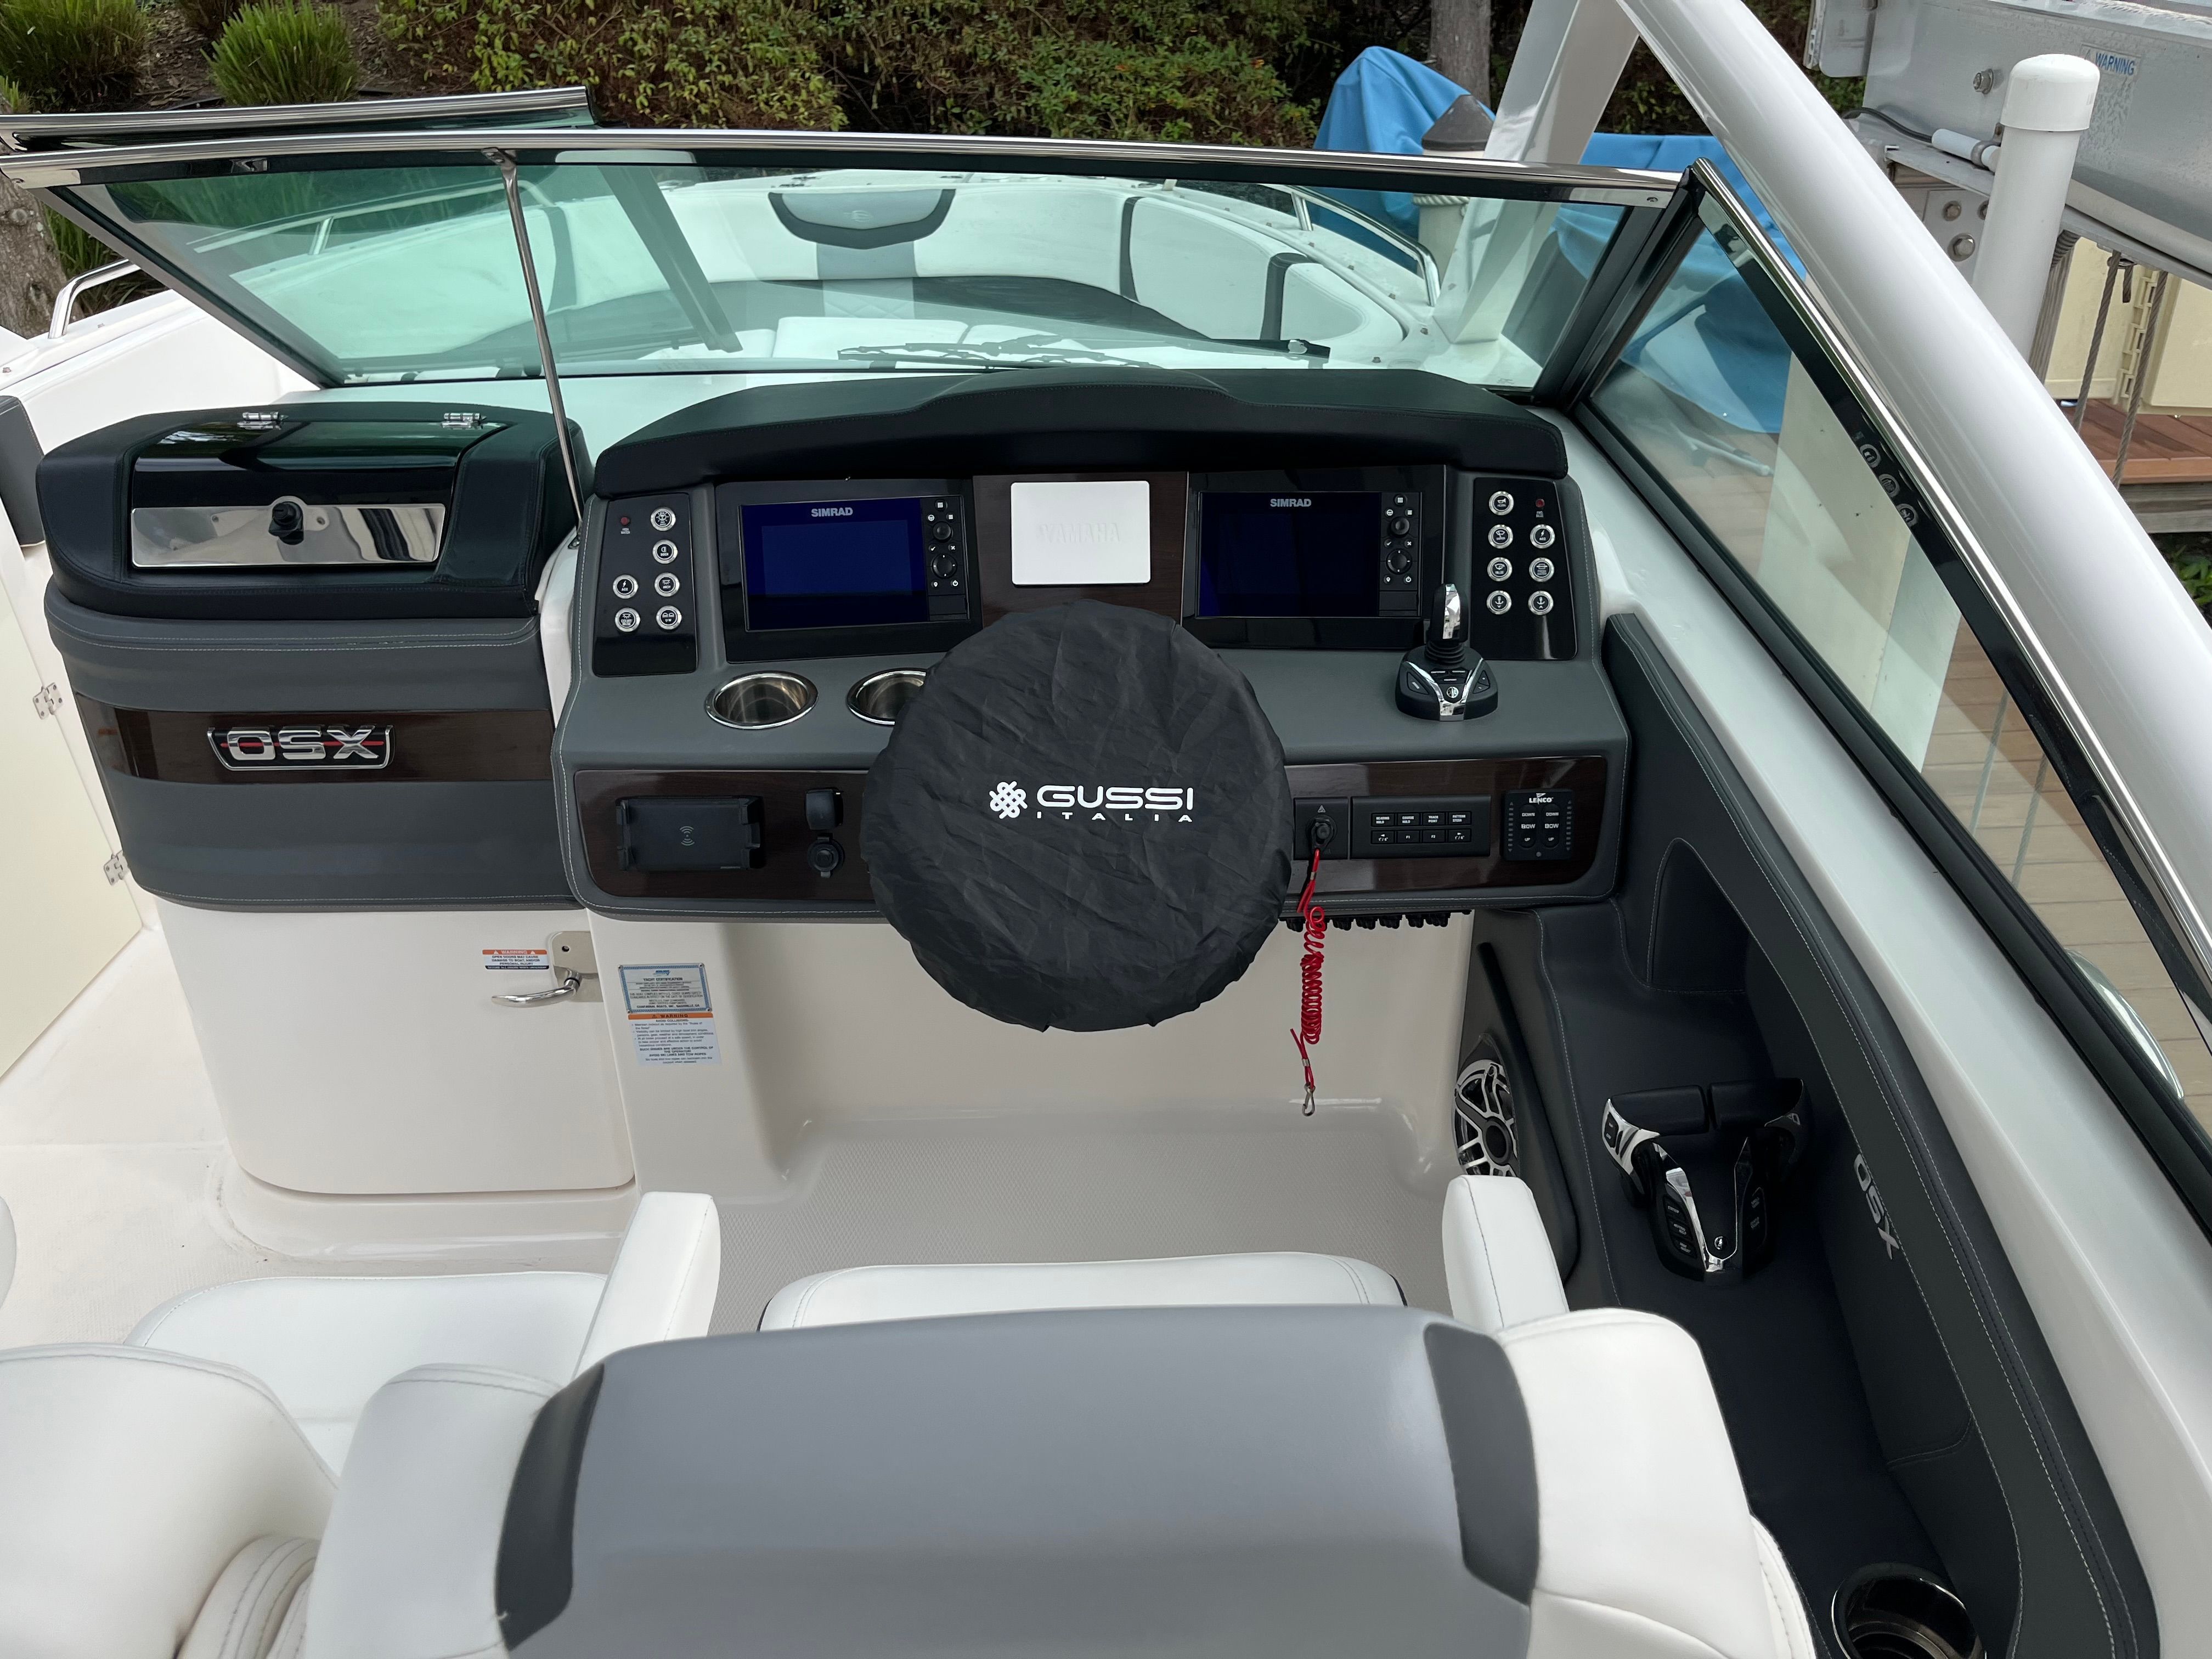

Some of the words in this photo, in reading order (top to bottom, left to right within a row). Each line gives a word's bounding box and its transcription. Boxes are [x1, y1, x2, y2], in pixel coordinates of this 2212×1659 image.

[2095, 53, 2136, 76] WARNING
[811, 507, 853, 517] SIMRAD
[1270, 498, 1312, 507] SIMRAD
[1038, 523, 1121, 543] YAMAHA
[1037, 785, 1194, 810] GUSSI
[1037, 811, 1193, 822] ITALIA
[1853, 1153, 1900, 1260] OSX
